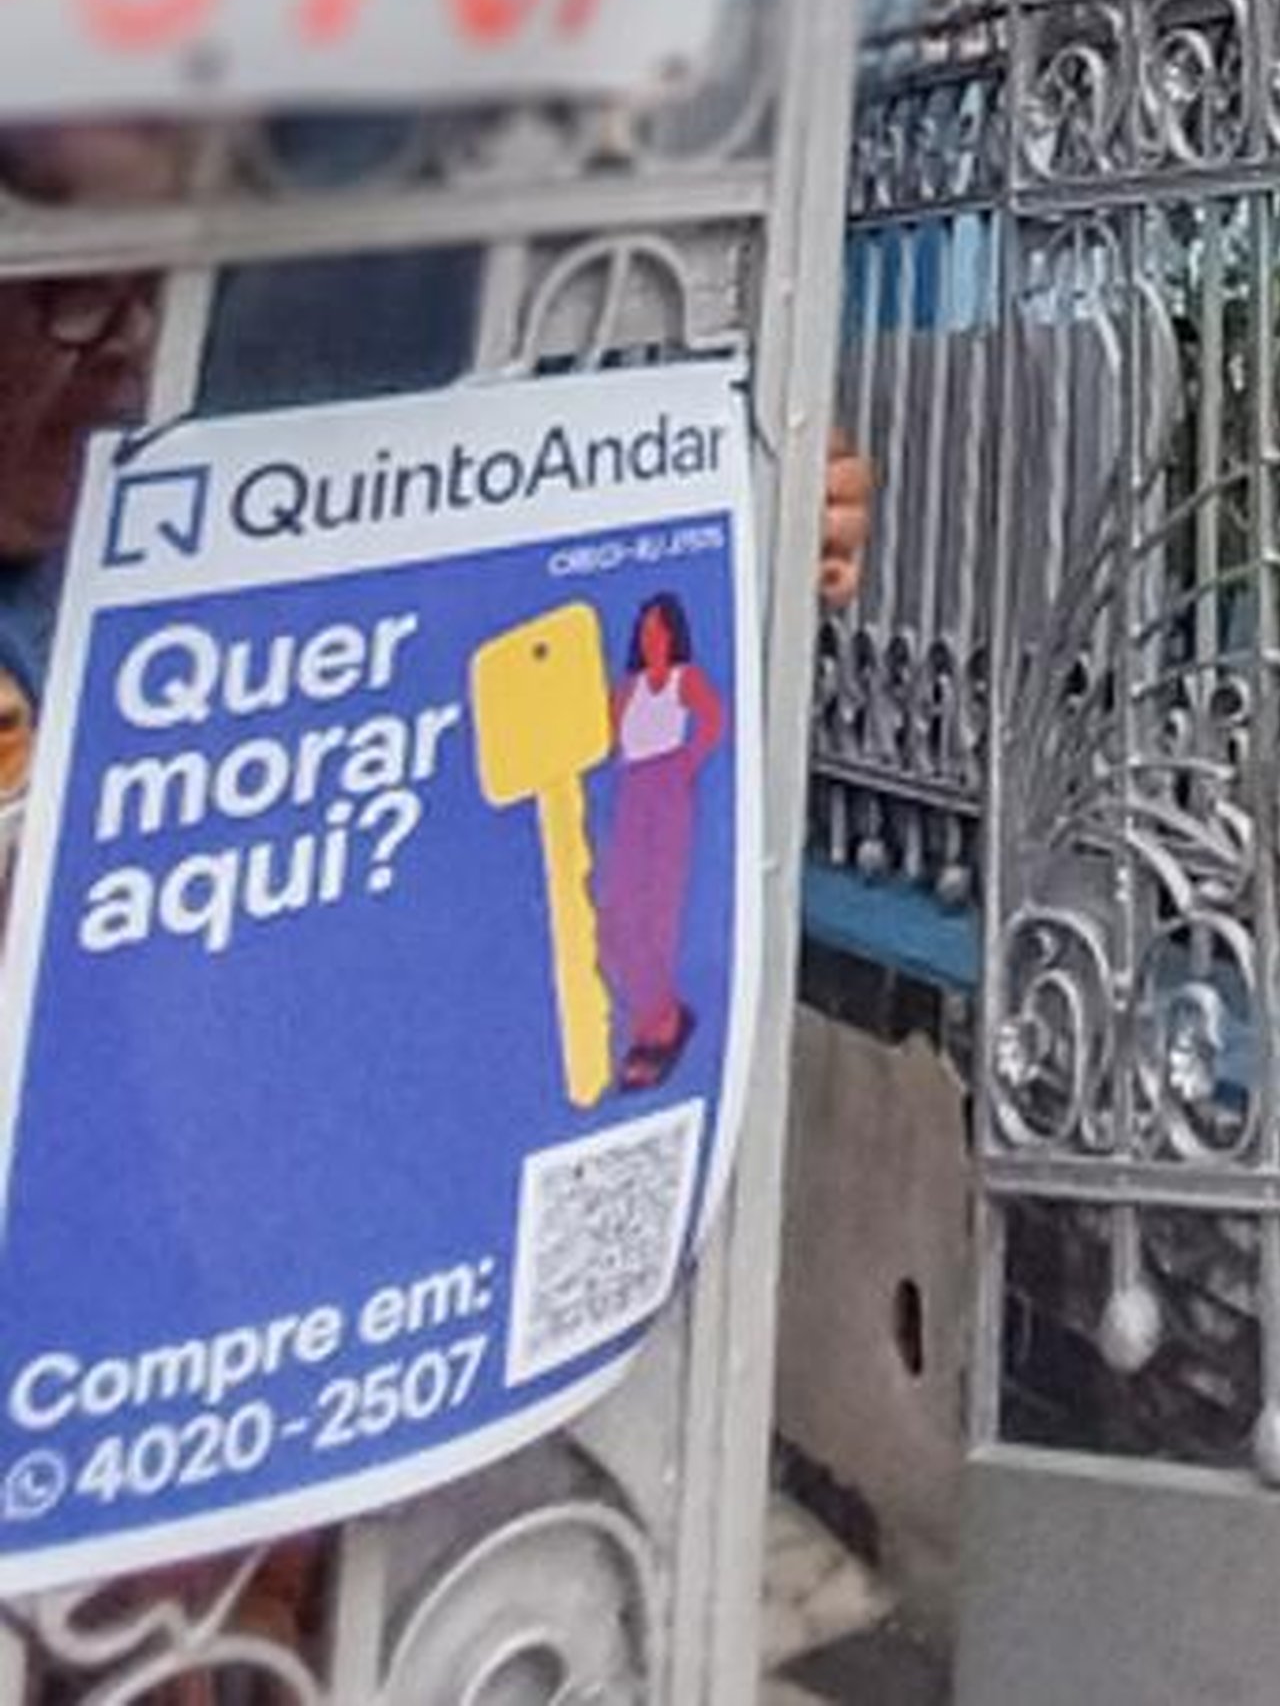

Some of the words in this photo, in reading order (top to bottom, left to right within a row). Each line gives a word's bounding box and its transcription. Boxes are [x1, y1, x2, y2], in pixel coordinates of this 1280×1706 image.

[230, 415, 726, 538] QuintoAndar
[115, 611, 419, 730] Quer
[94, 701, 461, 842] morar
[78, 790, 423, 952] aqui?
[9, 1301, 341, 1431] Compre
[359, 1255, 497, 1345] em:
[76, 1337, 486, 1502] 4020-2507
